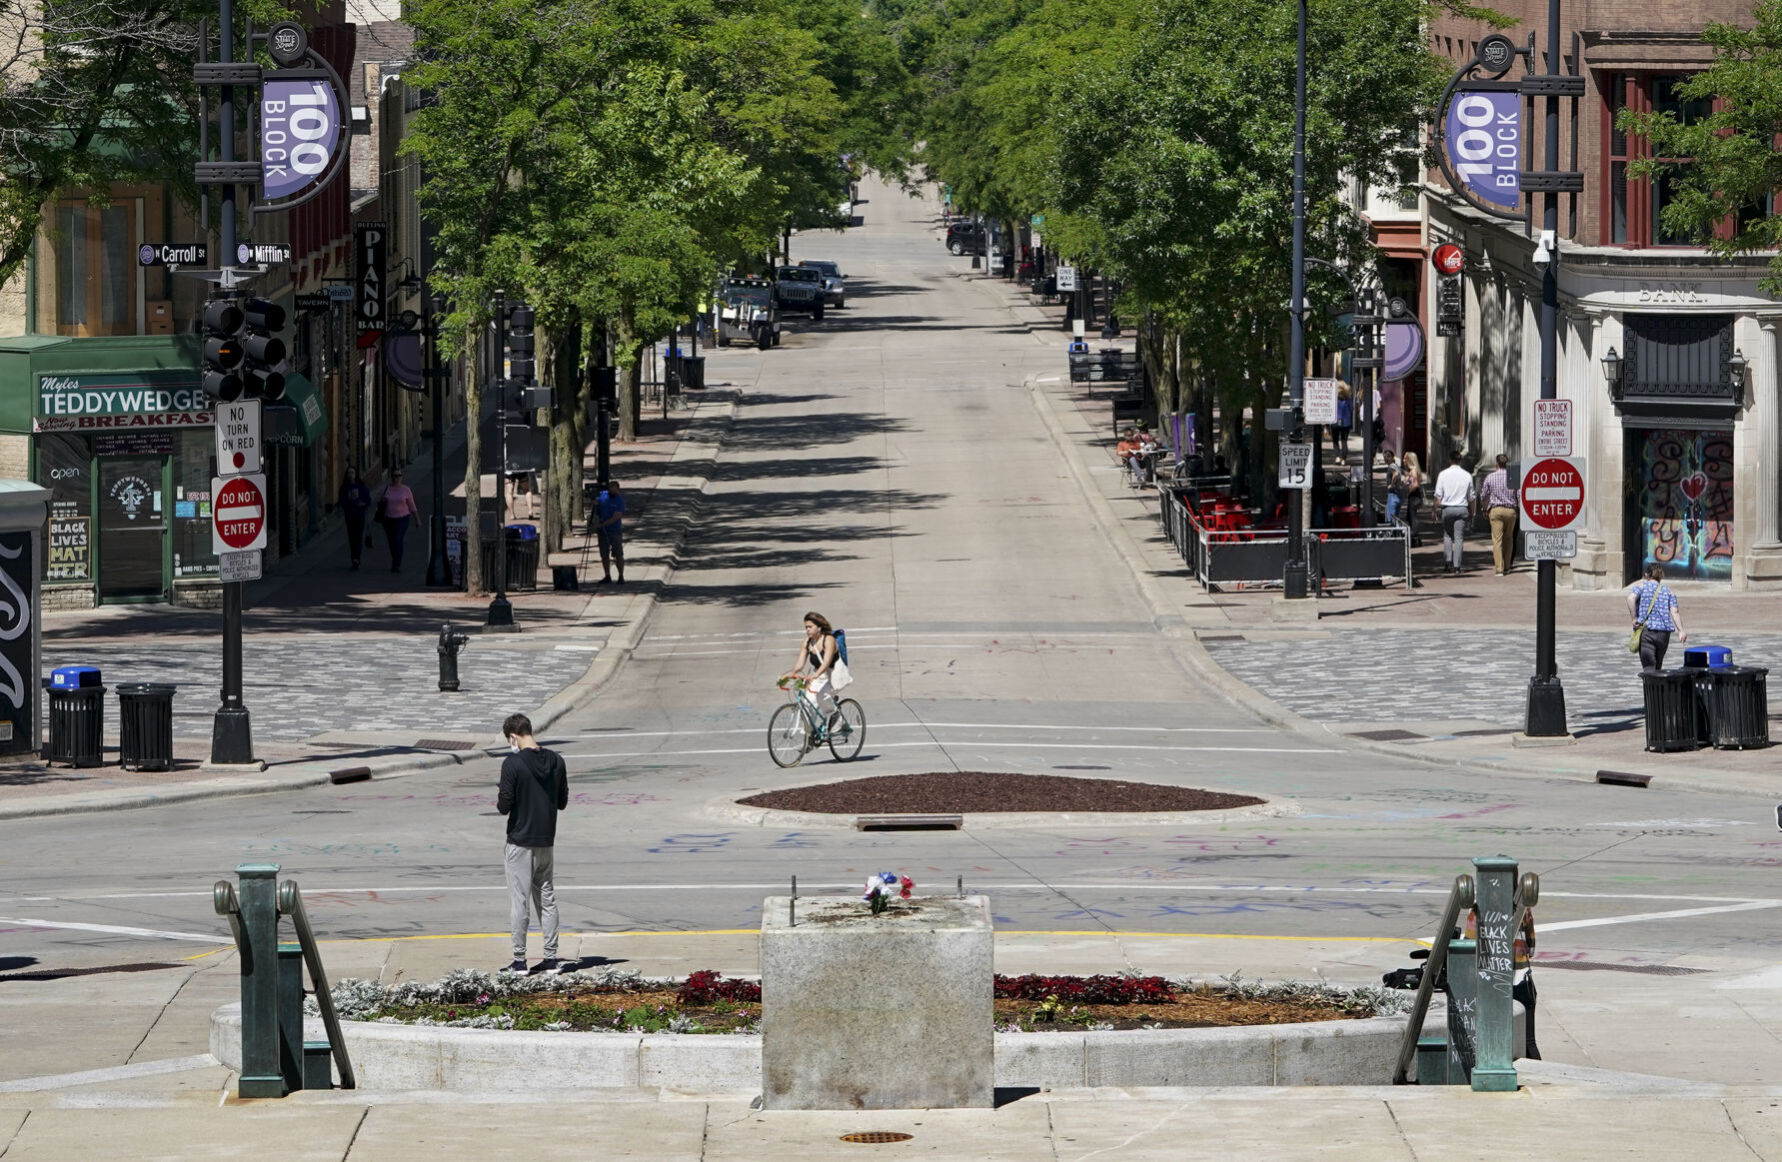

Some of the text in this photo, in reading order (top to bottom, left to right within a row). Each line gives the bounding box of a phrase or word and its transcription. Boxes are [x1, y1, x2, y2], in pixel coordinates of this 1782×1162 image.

[289, 85, 330, 175] 100
[264, 100, 288, 177] BLOCK
[1456, 95, 1495, 183] 100
[1496, 112, 1518, 187] BLOCK
[155, 245, 205, 262] N Carroll St
[255, 245, 283, 262] Mifflin
[283, 249, 290, 259] St
[363, 230, 381, 318] PIANO
[358, 320, 385, 329] BAR
[41, 377, 80, 393] Myles
[230, 407, 244, 421] NO
[1537, 402, 1568, 413] NO TRUCK
[227, 423, 249, 437] TURN
[1539, 420, 1567, 428] STANDING
[1541, 429, 1565, 437] PARKING
[222, 437, 255, 452] ON RED
[1282, 448, 1310, 457] SPEED
[1285, 458, 1308, 466] LIMIT
[1287, 469, 1305, 484] 15
[1532, 472, 1574, 484] DO NOT
[222, 492, 236, 505] DO
[237, 491, 257, 504] NOT
[1532, 504, 1573, 516] ENTER
[51, 522, 86, 534] BLACK
[224, 522, 256, 536] ENTER
[51, 534, 88, 547] LIVES
[50, 546, 87, 562] MAT
[1479, 925, 1508, 939] BLACK
[1479, 941, 1510, 954] LIVES
[1477, 957, 1512, 971] MATTER
